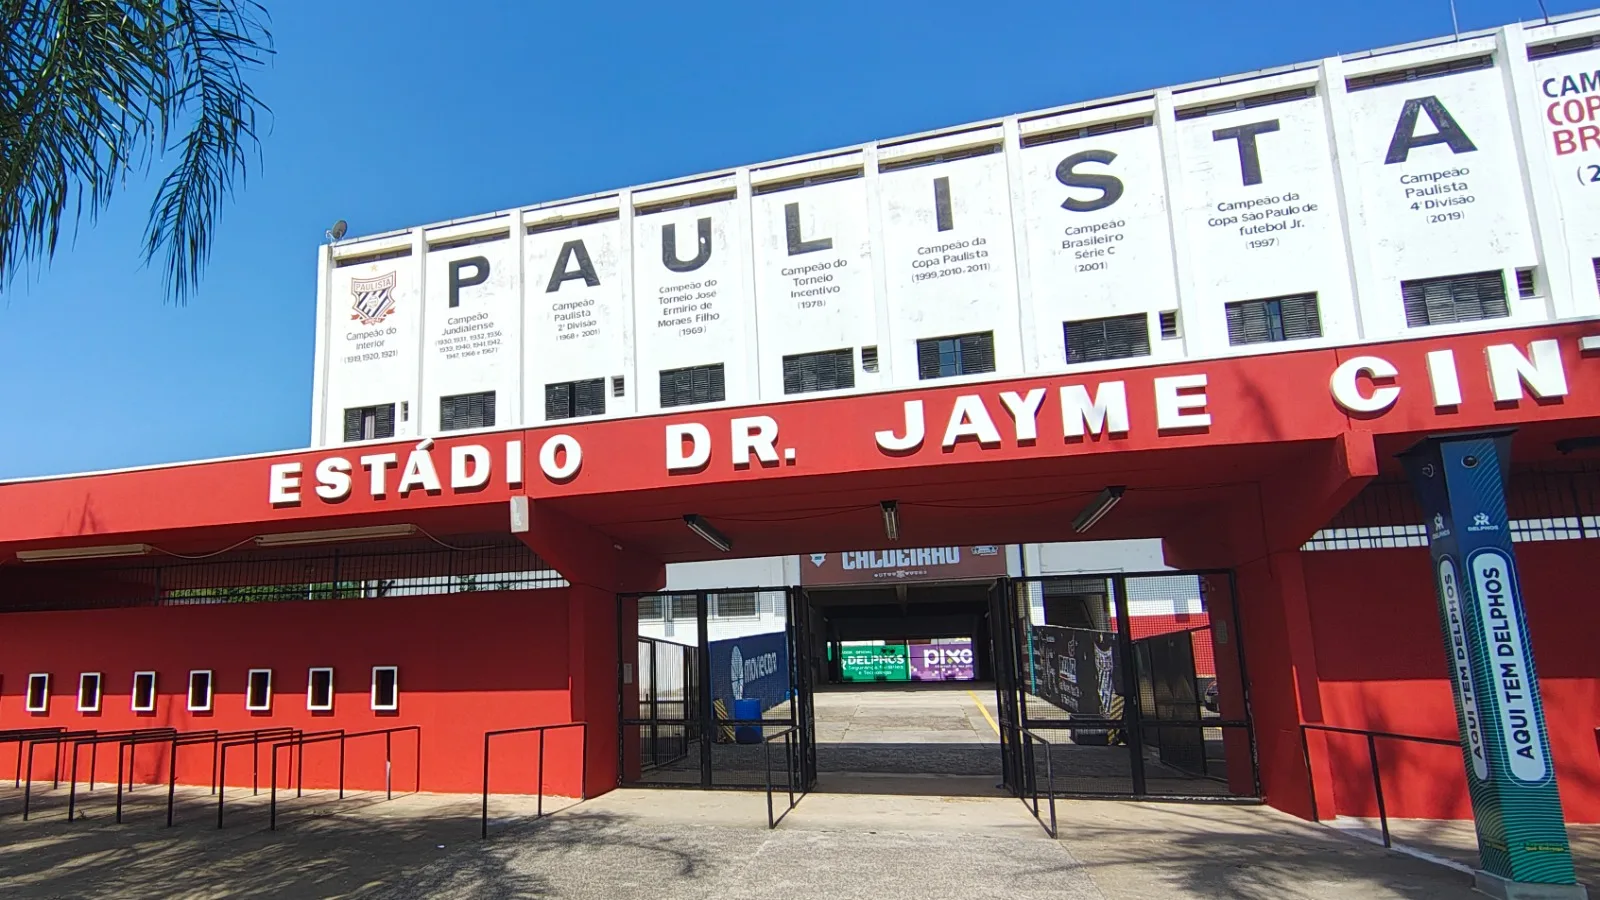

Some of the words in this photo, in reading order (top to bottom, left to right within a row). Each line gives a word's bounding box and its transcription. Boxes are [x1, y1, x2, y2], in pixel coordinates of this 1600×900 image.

[1400, 167, 1470, 185] Campeão
[1404, 182, 1469, 199] Paulista
[1217, 196, 1280, 211] Campeão
[1282, 192, 1300, 202] da
[1424, 195, 1476, 210] Divisão
[1207, 216, 1238, 227] Copa
[1241, 212, 1264, 223] São
[1265, 206, 1300, 219] Paulo
[1301, 203, 1318, 213] de
[1426, 210, 1465, 224] (2019)
[1064, 218, 1126, 236] Campeão
[1239, 220, 1287, 236] futebol
[1289, 218, 1305, 230] Jr.
[917, 240, 970, 255] Campeão
[971, 237, 987, 246] da
[1062, 233, 1124, 250] Brasileiro
[1245, 237, 1280, 250] (1997)
[911, 257, 940, 269] Copa
[943, 250, 989, 264] Paulista
[1074, 248, 1105, 260] Série
[1107, 246, 1116, 255] C
[781, 261, 831, 276] Campeão
[833, 259, 848, 268] do
[1074, 260, 1108, 273] (2001)
[355, 278, 391, 291] PAULISTA
[659, 281, 702, 294] Campeão
[704, 279, 718, 288] do
[793, 273, 834, 287] Torneio
[658, 293, 693, 305] Torneio
[790, 285, 841, 298] Incentivo
[552, 299, 595, 311] Campeão
[700, 302, 713, 310] de
[797, 299, 826, 309] (1978)
[448, 312, 489, 325] Campeão
[554, 310, 591, 322] Paulista
[657, 317, 692, 328] Moraes
[695, 313, 720, 323] Filho
[442, 321, 494, 336] Jundiaiense
[567, 319, 597, 330] Divisão
[679, 325, 707, 337] (1969)
[346, 329, 384, 341] Campeão
[386, 326, 397, 335] do
[356, 340, 385, 350] Interior
[269, 434, 583, 505] ESTÁDIO
[665, 416, 796, 471] DR.
[875, 373, 1212, 452] JAYME
[1444, 573, 1466, 660] DELPHOS
[1482, 567, 1515, 657] DELPHOS
[847, 655, 905, 665] DELPHOS
[1459, 666, 1473, 704] TEM
[1500, 663, 1523, 703] TEM
[1464, 710, 1483, 759] AQUI
[1507, 709, 1535, 760] AQUI
